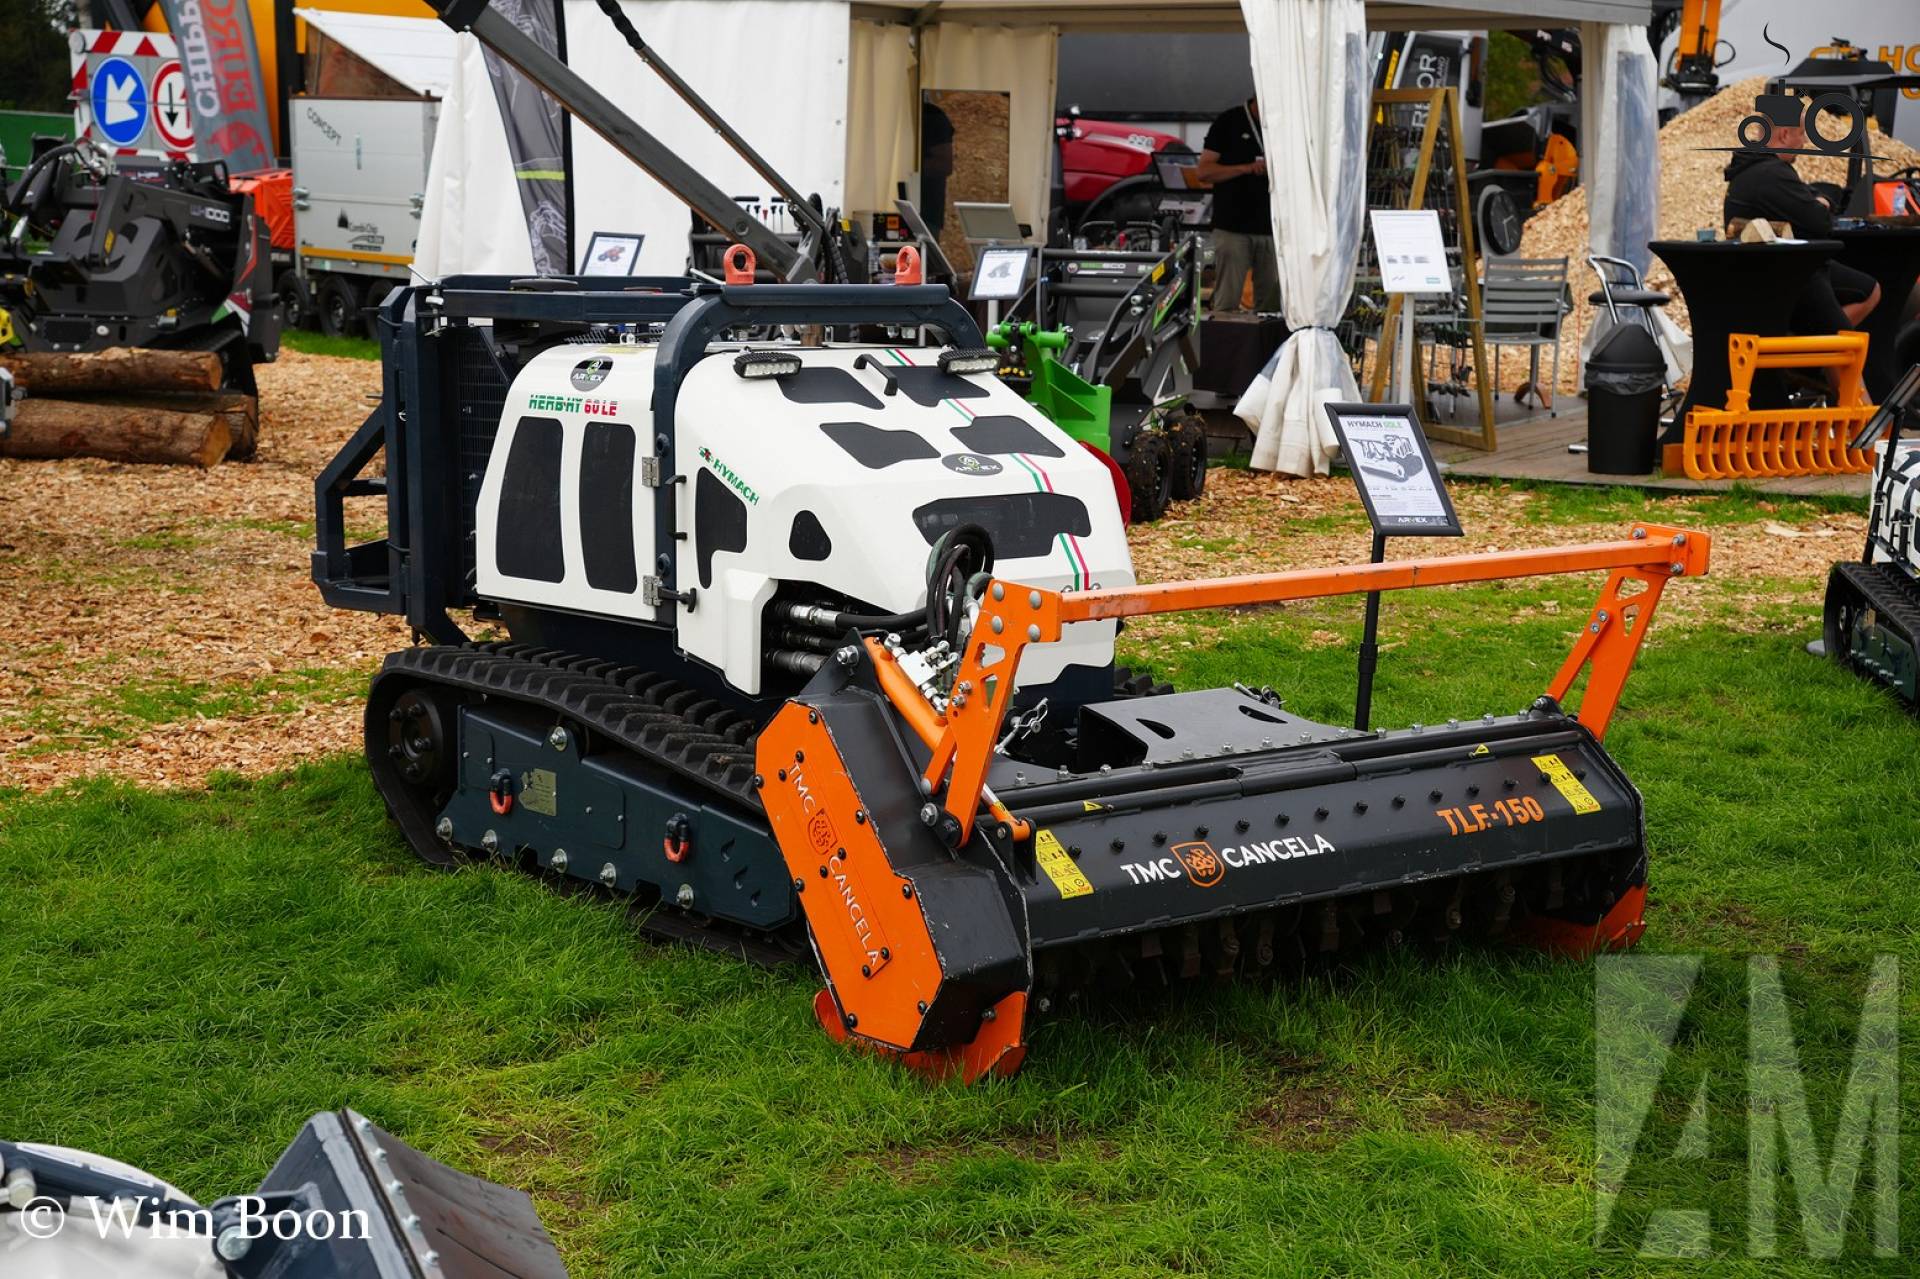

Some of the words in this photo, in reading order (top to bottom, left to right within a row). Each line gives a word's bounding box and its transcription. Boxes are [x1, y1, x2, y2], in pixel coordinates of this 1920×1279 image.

[307, 107, 342, 146] CONCEPT
[1347, 420, 1383, 428] HYMACH
[713, 458, 760, 506] HYMACH
[790, 759, 816, 814] TMC
[829, 854, 880, 967] CANCELA
[1120, 857, 1182, 885] TMC
[1221, 833, 1336, 868] CANCELA
